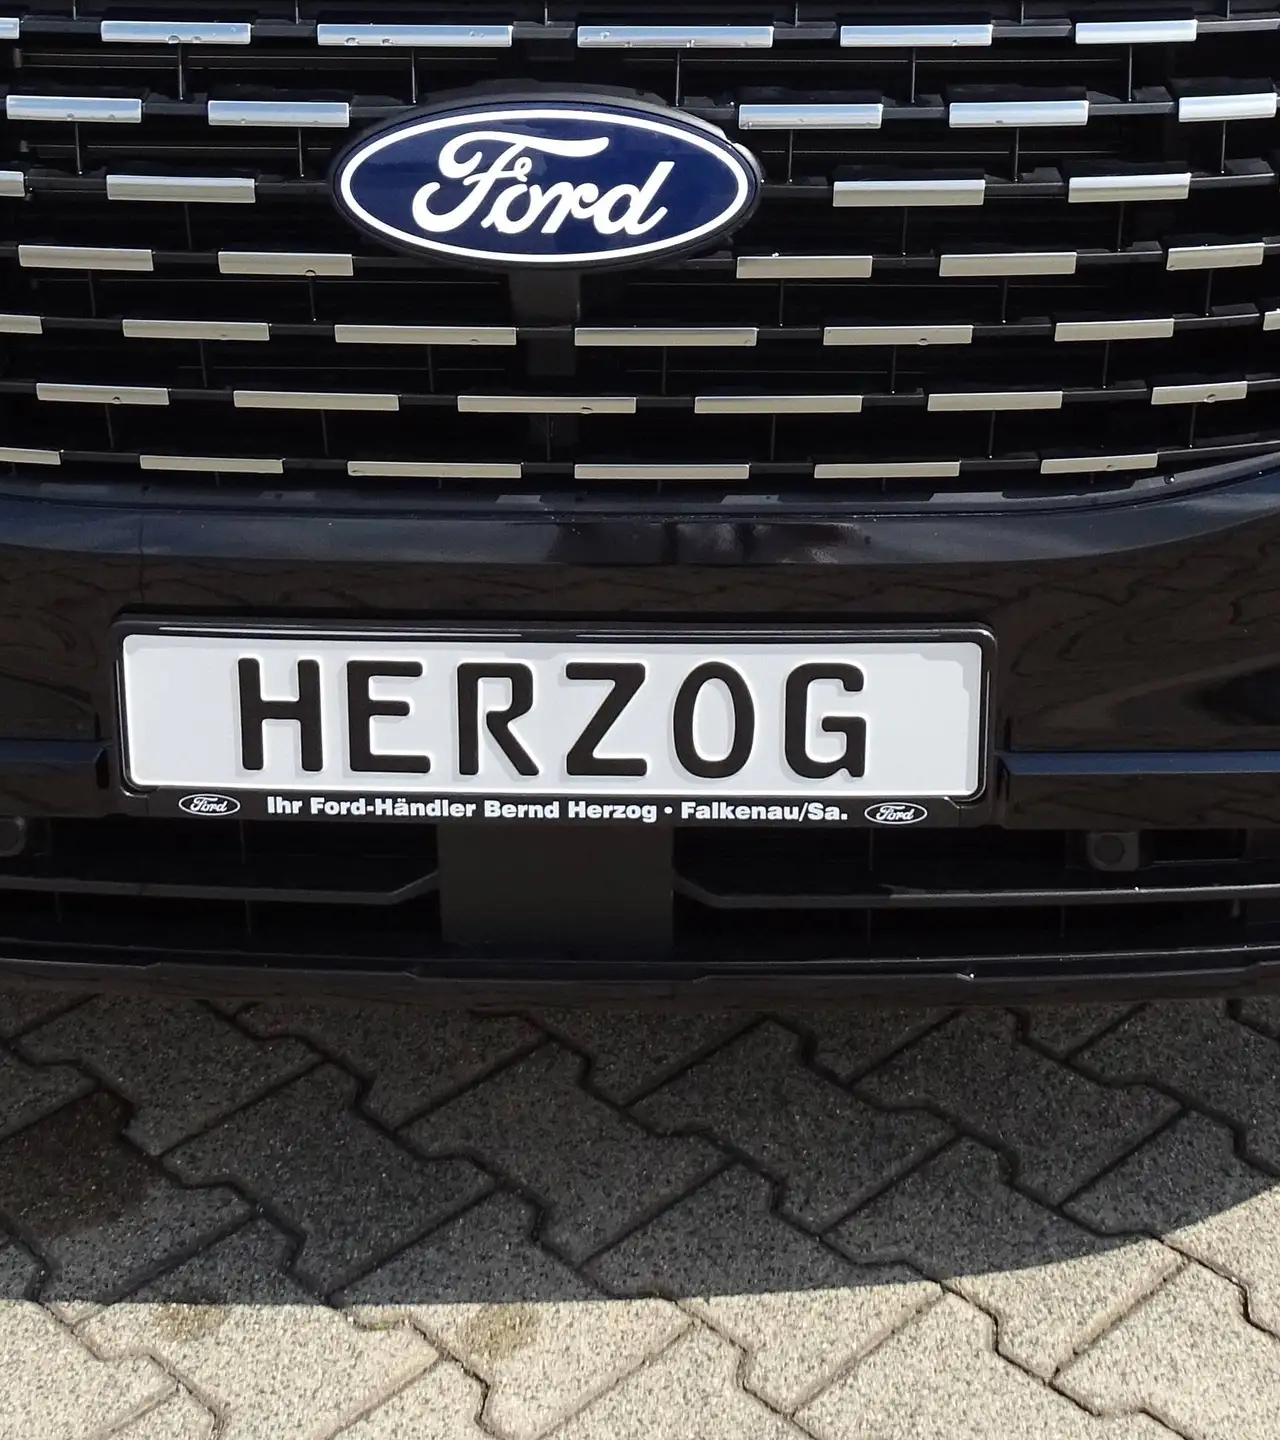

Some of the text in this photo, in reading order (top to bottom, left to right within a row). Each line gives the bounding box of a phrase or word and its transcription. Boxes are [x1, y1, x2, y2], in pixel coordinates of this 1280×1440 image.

[412, 130, 675, 235] Ford
[238, 657, 867, 779] HERZOG
[189, 795, 228, 813] Ford
[266, 796, 849, 822] Ihr Ford-Händler Bernd Herzog Falkenau/Sa.
[875, 803, 915, 822] Ford
